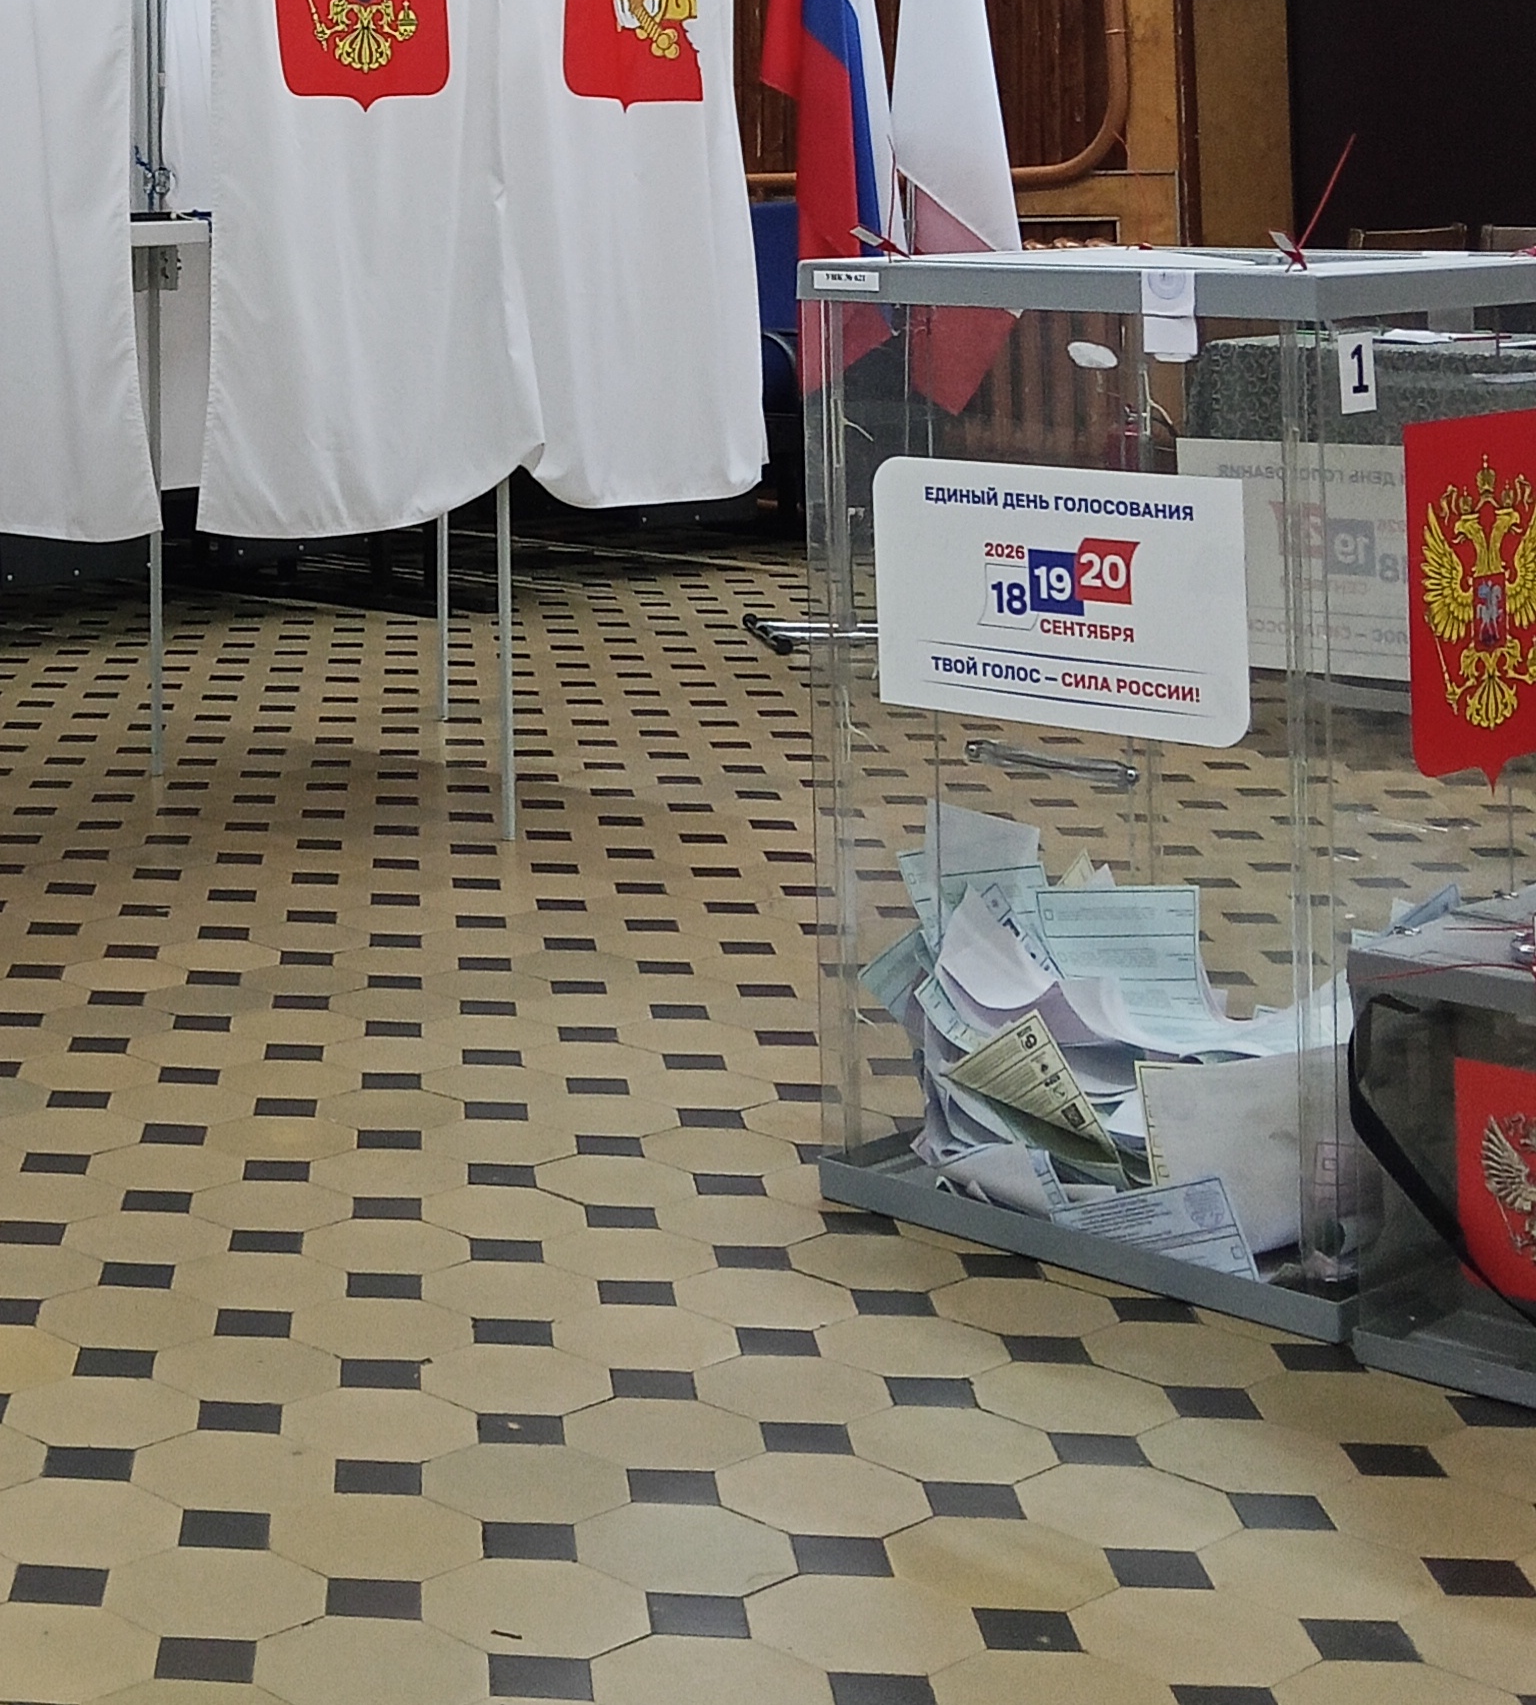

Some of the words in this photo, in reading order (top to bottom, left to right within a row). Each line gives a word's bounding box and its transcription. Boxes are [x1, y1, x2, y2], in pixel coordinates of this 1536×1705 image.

[1351, 344, 1369, 394] 1
[924, 486, 999, 507] ЕДИНЫЙ
[1002, 492, 1050, 511] ДЕНЬ
[1054, 496, 1195, 522] ГОЛОСОВАНИЯ
[984, 542, 1026, 560] 2026
[990, 581, 1028, 616] 18
[1033, 565, 1072, 601] 19
[1079, 552, 1127, 590] 20
[1039, 618, 1135, 643] СЕНТЯБРЯ
[931, 655, 979, 677] ТВОЙ
[982, 662, 1041, 684] ГОЛОС
[1061, 672, 1112, 693] СИЛА
[1116, 679, 1201, 703] РОССИИ!
